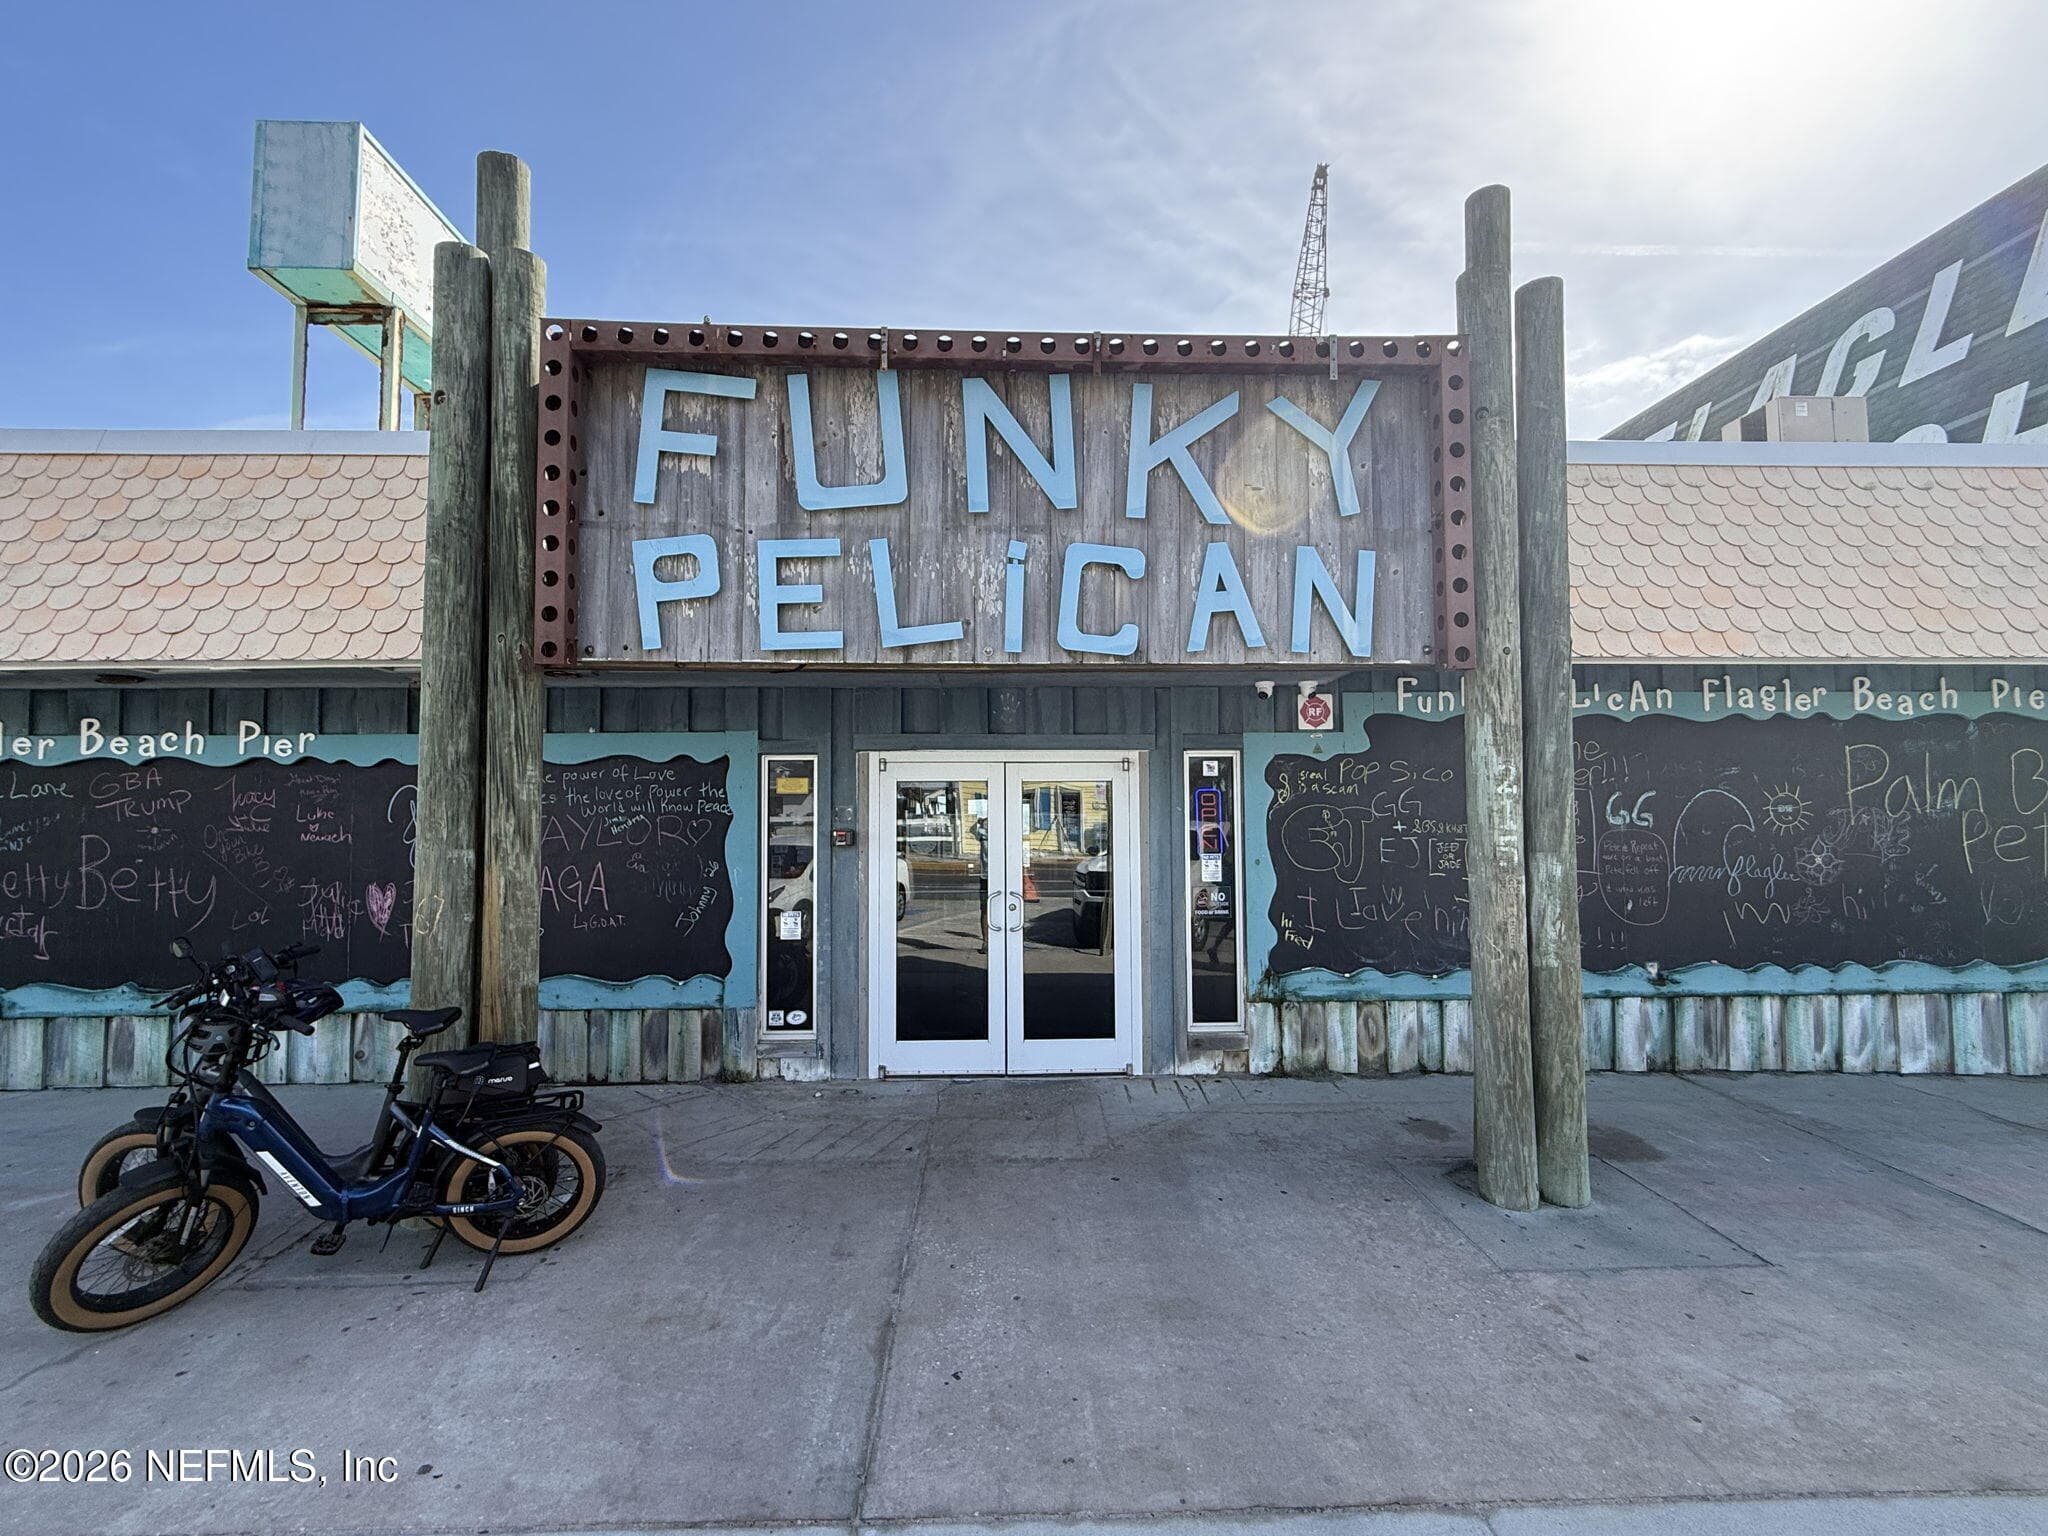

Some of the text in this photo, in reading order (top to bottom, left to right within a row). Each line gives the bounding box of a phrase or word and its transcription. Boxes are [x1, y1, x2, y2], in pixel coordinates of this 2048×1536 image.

[632, 367, 1382, 526] FUNKY
[1702, 675, 1826, 712] Flagler
[1852, 676, 1958, 714] Beach
[1991, 678, 2045, 710] Pie
[1308, 707, 1323, 717] RF
[80, 718, 205, 758] Beach
[239, 720, 316, 757] Pier
[562, 768, 605, 790] power
[612, 763, 629, 783] of
[634, 766, 677, 782] Love
[1322, 783, 1359, 796] scam
[1844, 744, 1985, 827] Palm
[565, 786, 590, 807] the
[699, 781, 726, 798] the
[631, 799, 656, 813] will
[541, 813, 690, 852] AYLOR
[1211, 892, 1226, 902] NO
[1284, 929, 1313, 951] Fred
